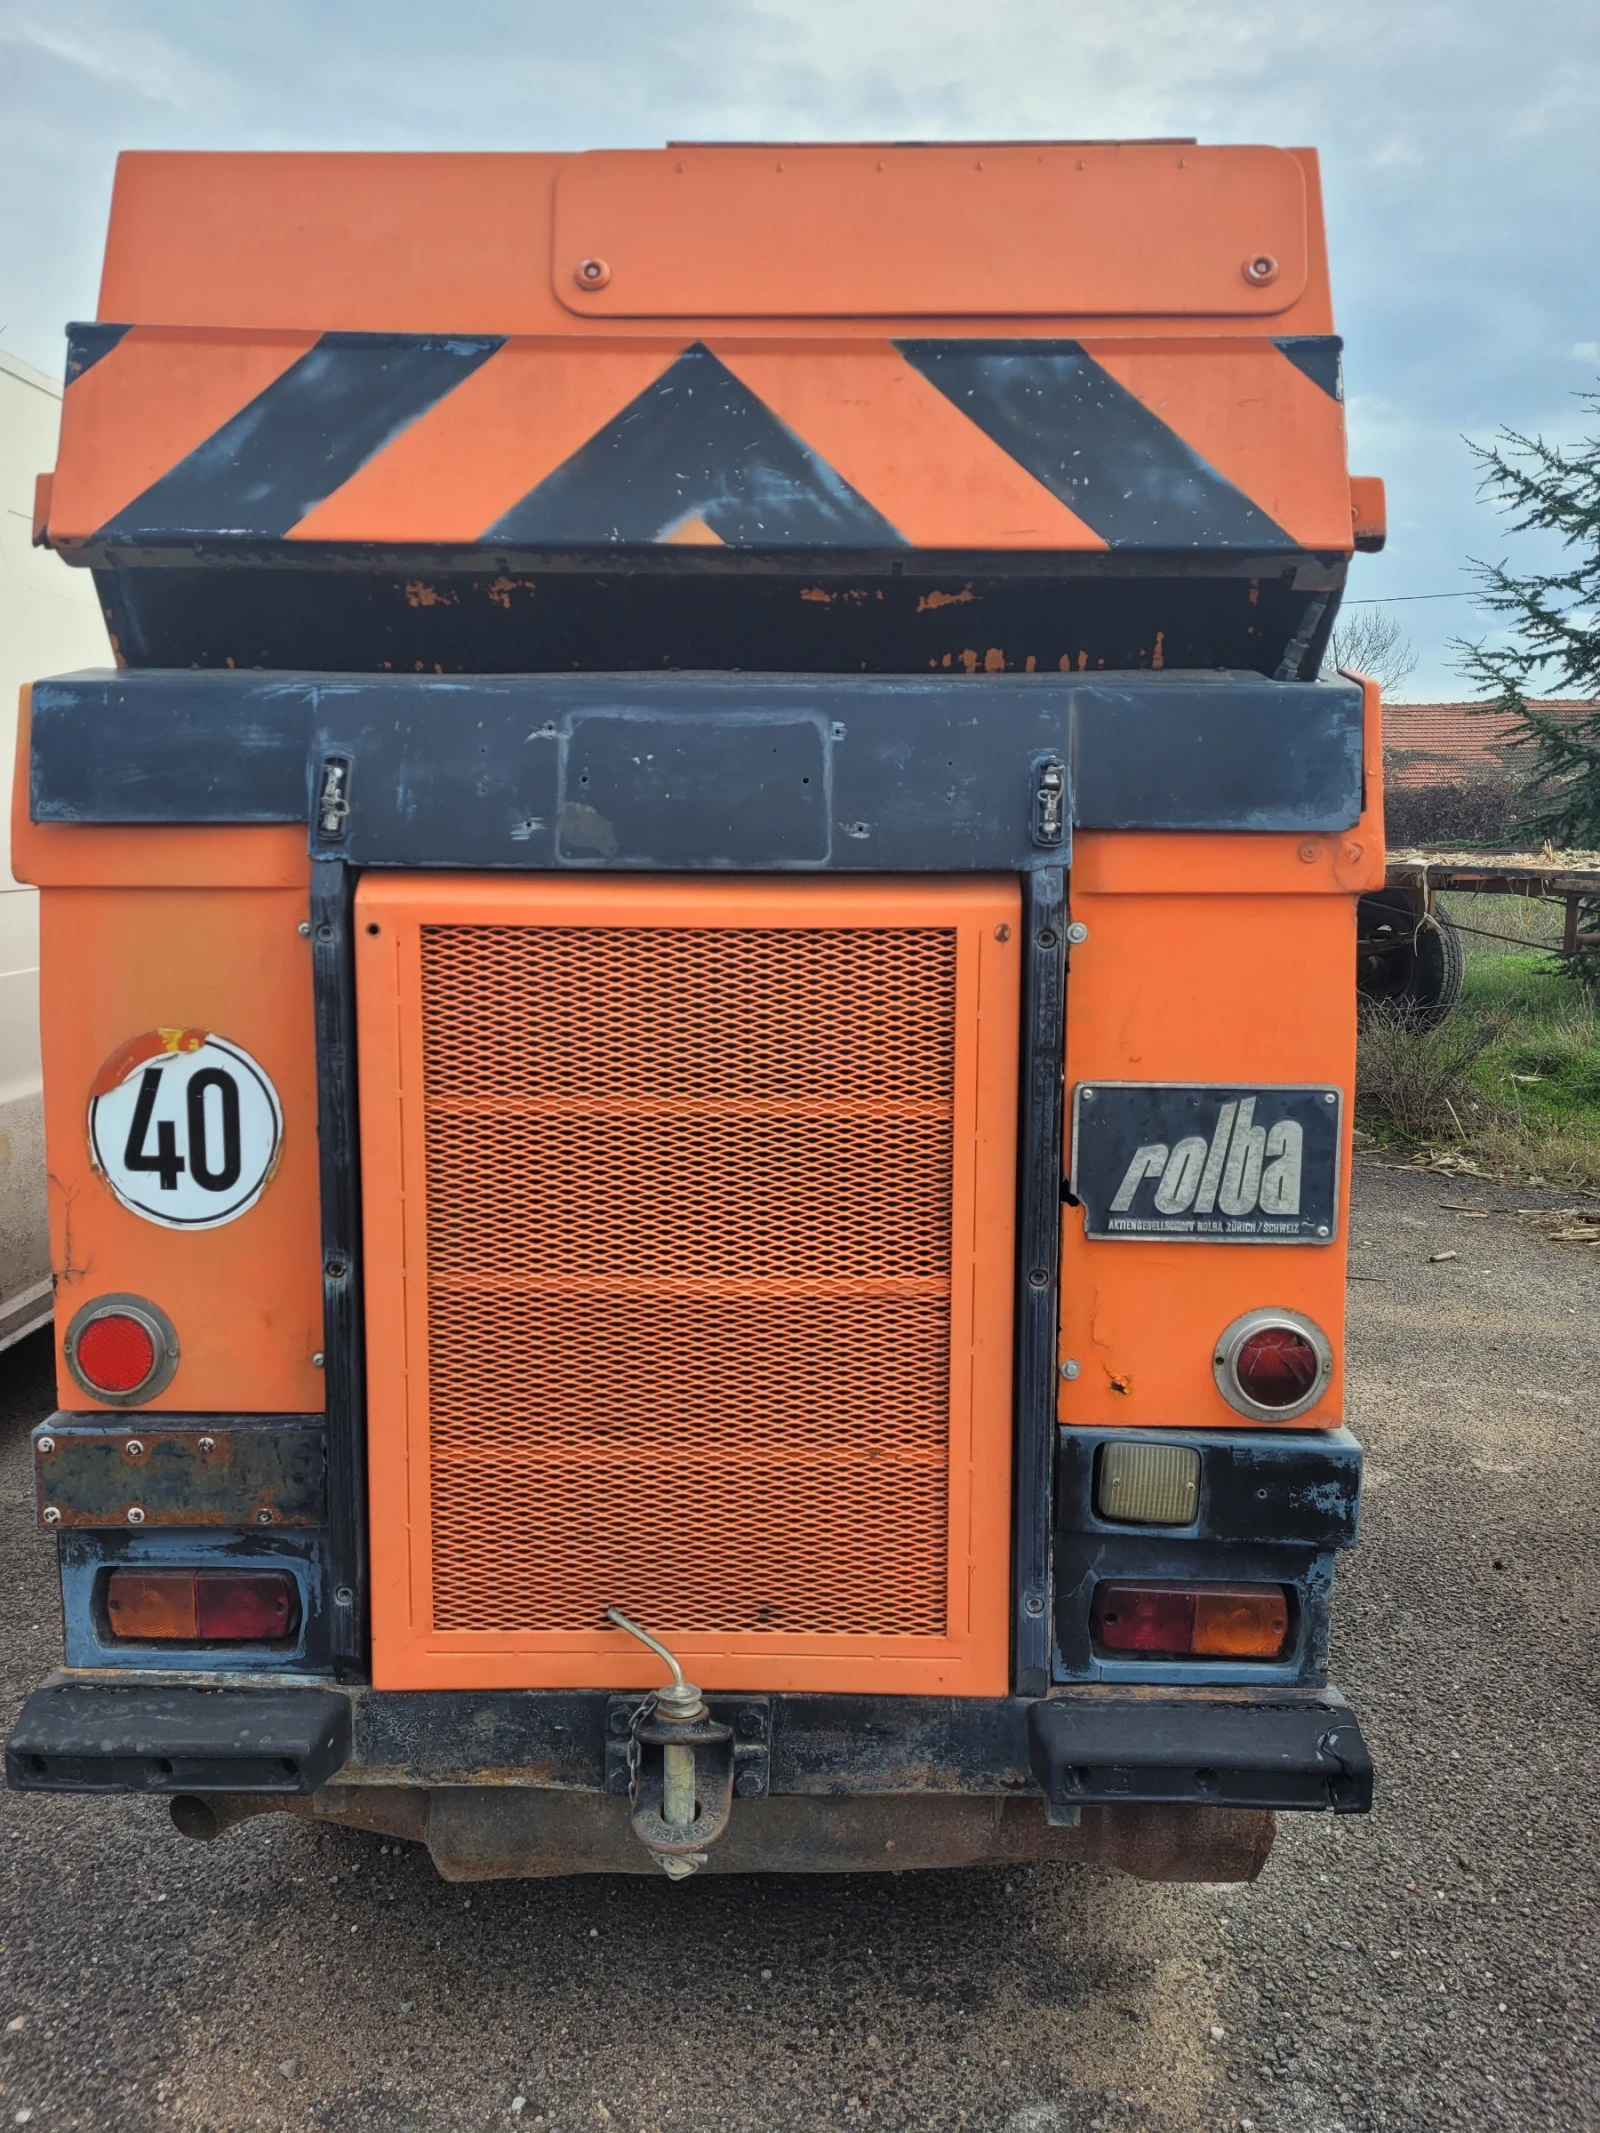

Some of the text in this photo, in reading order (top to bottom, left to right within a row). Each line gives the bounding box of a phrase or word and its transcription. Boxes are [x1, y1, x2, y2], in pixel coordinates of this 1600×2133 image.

[124, 1066, 241, 1192] 40
[1108, 1096, 1303, 1216] rolba
[1197, 1220, 1224, 1232] ROLBA
